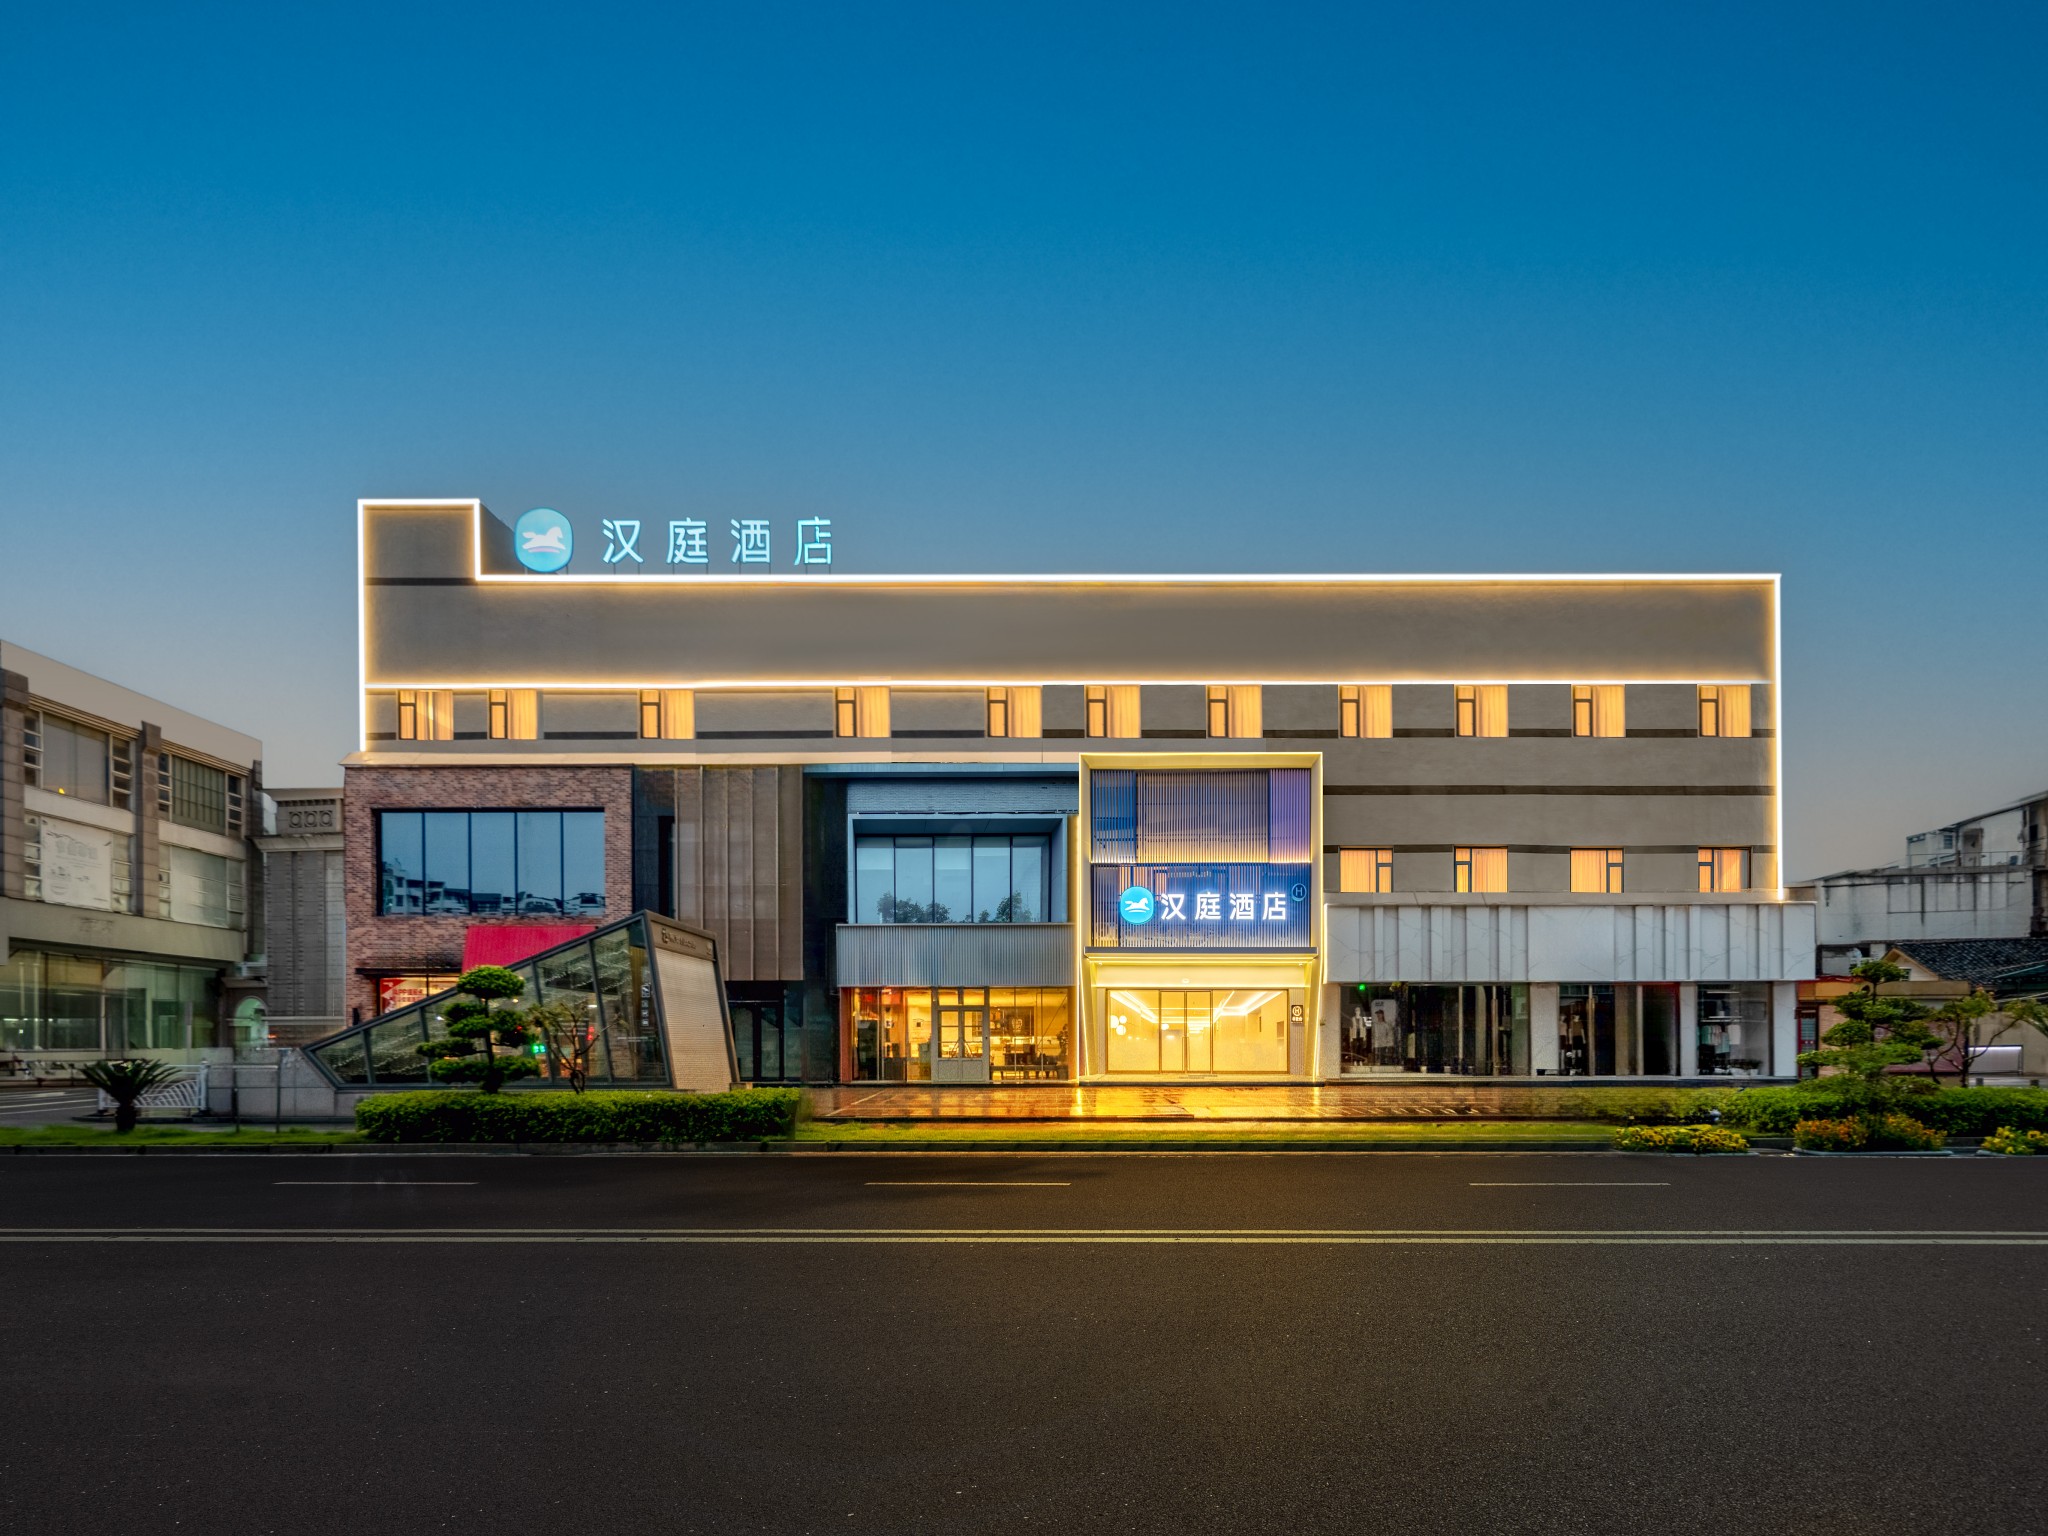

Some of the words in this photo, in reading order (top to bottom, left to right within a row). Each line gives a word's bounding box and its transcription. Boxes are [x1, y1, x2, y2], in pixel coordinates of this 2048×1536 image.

[602, 516, 832, 566] 汉庭酒店
[1161, 891, 1287, 921] 汉庭酒店
